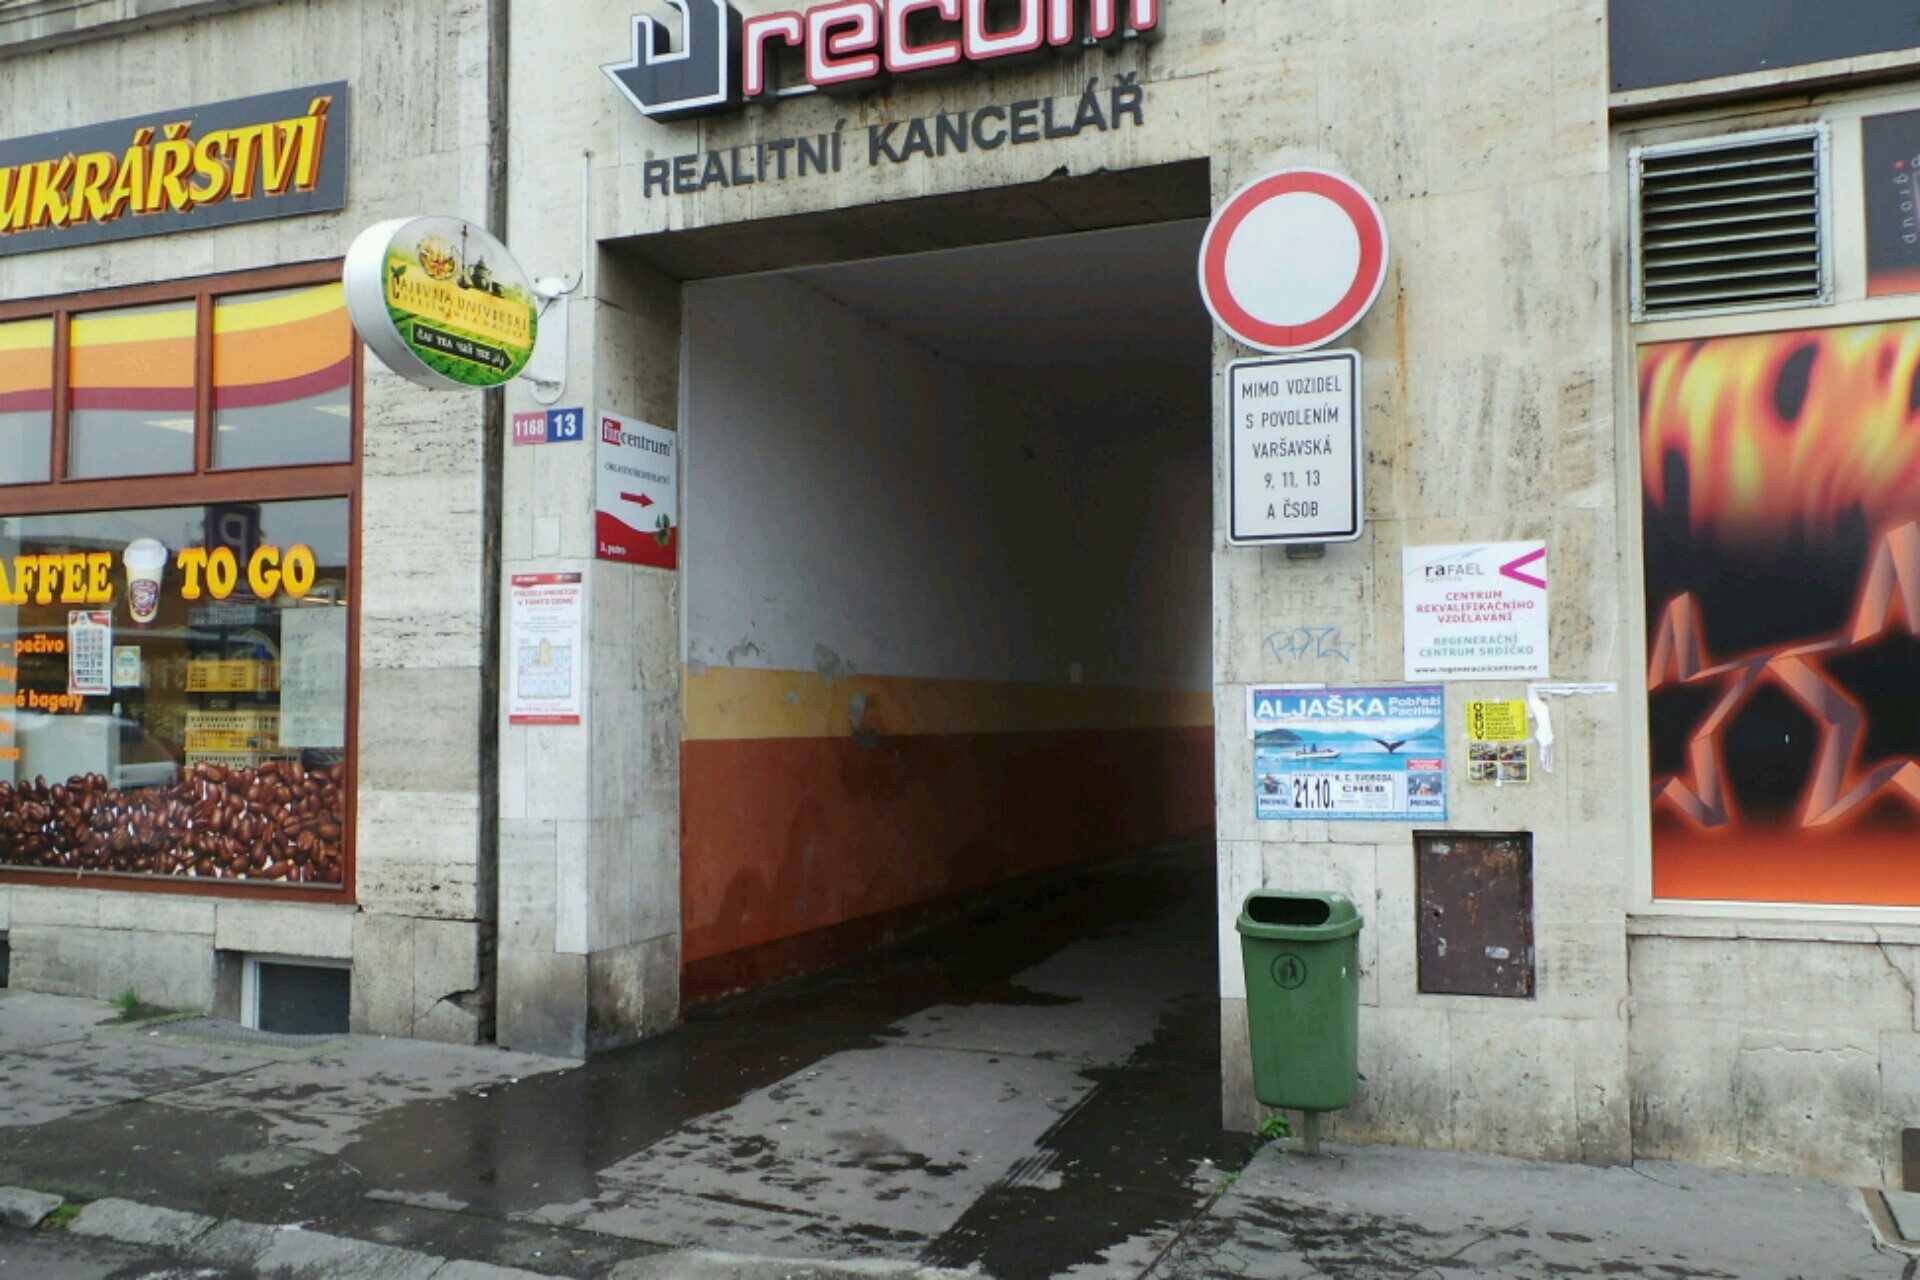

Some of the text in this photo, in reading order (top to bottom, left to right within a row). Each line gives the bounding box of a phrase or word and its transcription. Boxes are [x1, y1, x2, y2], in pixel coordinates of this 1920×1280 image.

[742, 0, 1157, 95] recom
[643, 71, 1144, 198] REALITNÍ KANCELÁŘ
[1242, 375, 1342, 399] MIMO VOZIDEL
[515, 413, 576, 438] 1168 13
[1246, 402, 1338, 429] S POVOLENÍM
[1252, 434, 1332, 459] VARŠAVSKÁ
[1264, 470, 1320, 489] 9. 11. 13
[1266, 497, 1318, 519] A ČSOB
[177, 546, 237, 599] TO
[248, 544, 315, 598] GO
[1416, 599, 1535, 613] REKVALIFIKAČNÍHO
[1445, 590, 1502, 601] CENTRUM
[14, 634, 65, 658] pečivo
[1433, 631, 1519, 645] REGENERAČNÍ
[1419, 643, 1534, 658] CENTRUM SRDÍČKO
[1256, 694, 1387, 718] ALJAŠKA
[1294, 778, 1334, 808] 21.10.
[1342, 785, 1385, 793] CHEB
